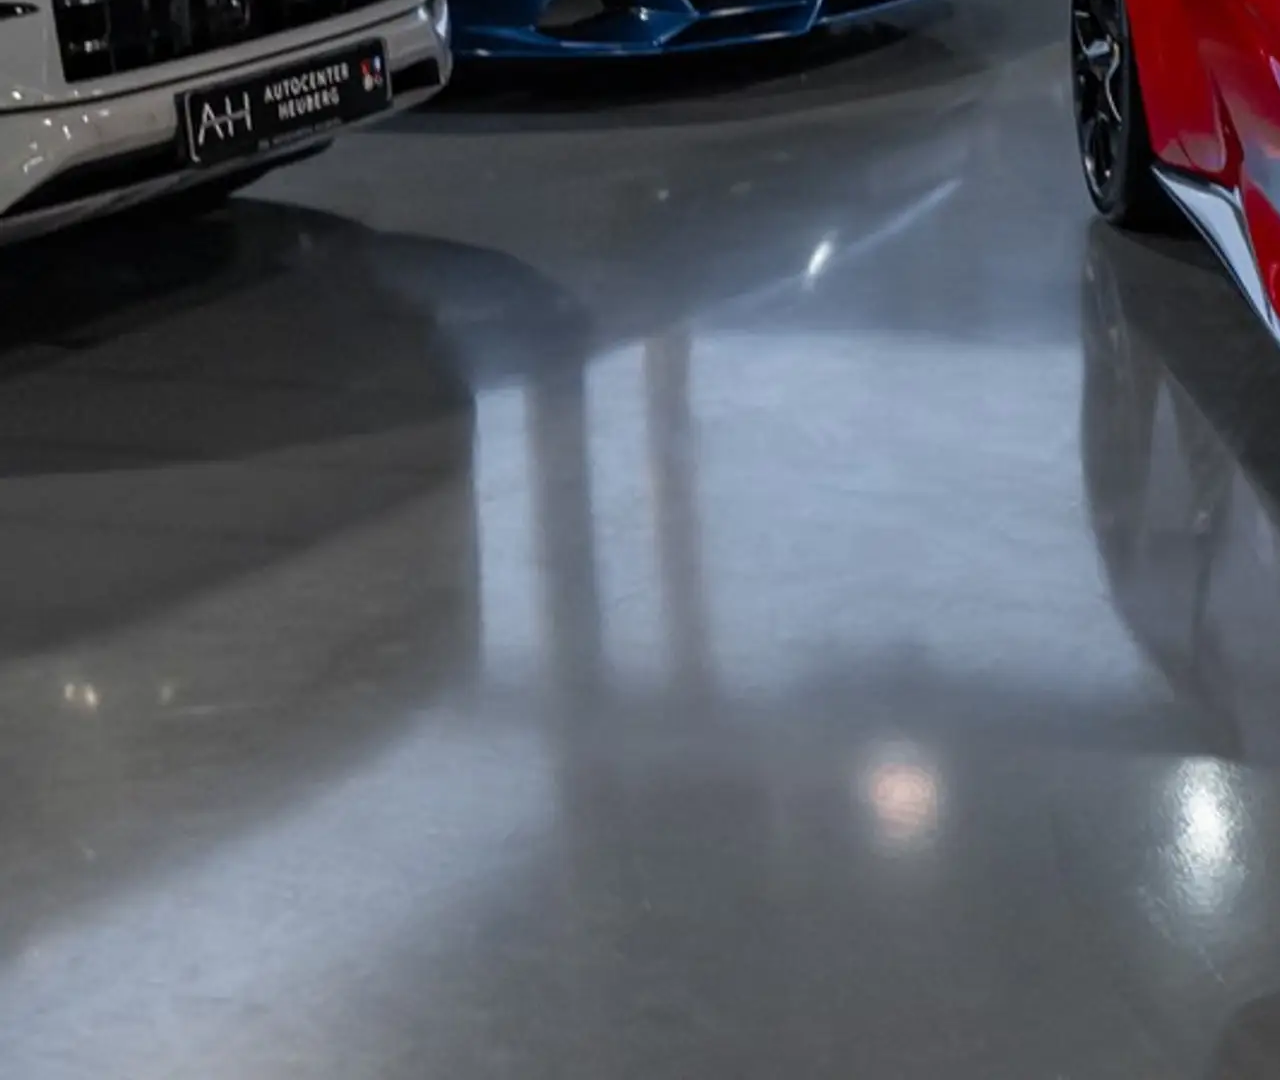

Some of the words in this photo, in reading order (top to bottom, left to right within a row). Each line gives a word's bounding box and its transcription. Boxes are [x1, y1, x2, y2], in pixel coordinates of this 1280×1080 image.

[263, 61, 350, 105] AUTOCENTER
[277, 85, 341, 121] HEUBERG
[198, 90, 253, 146] AH
